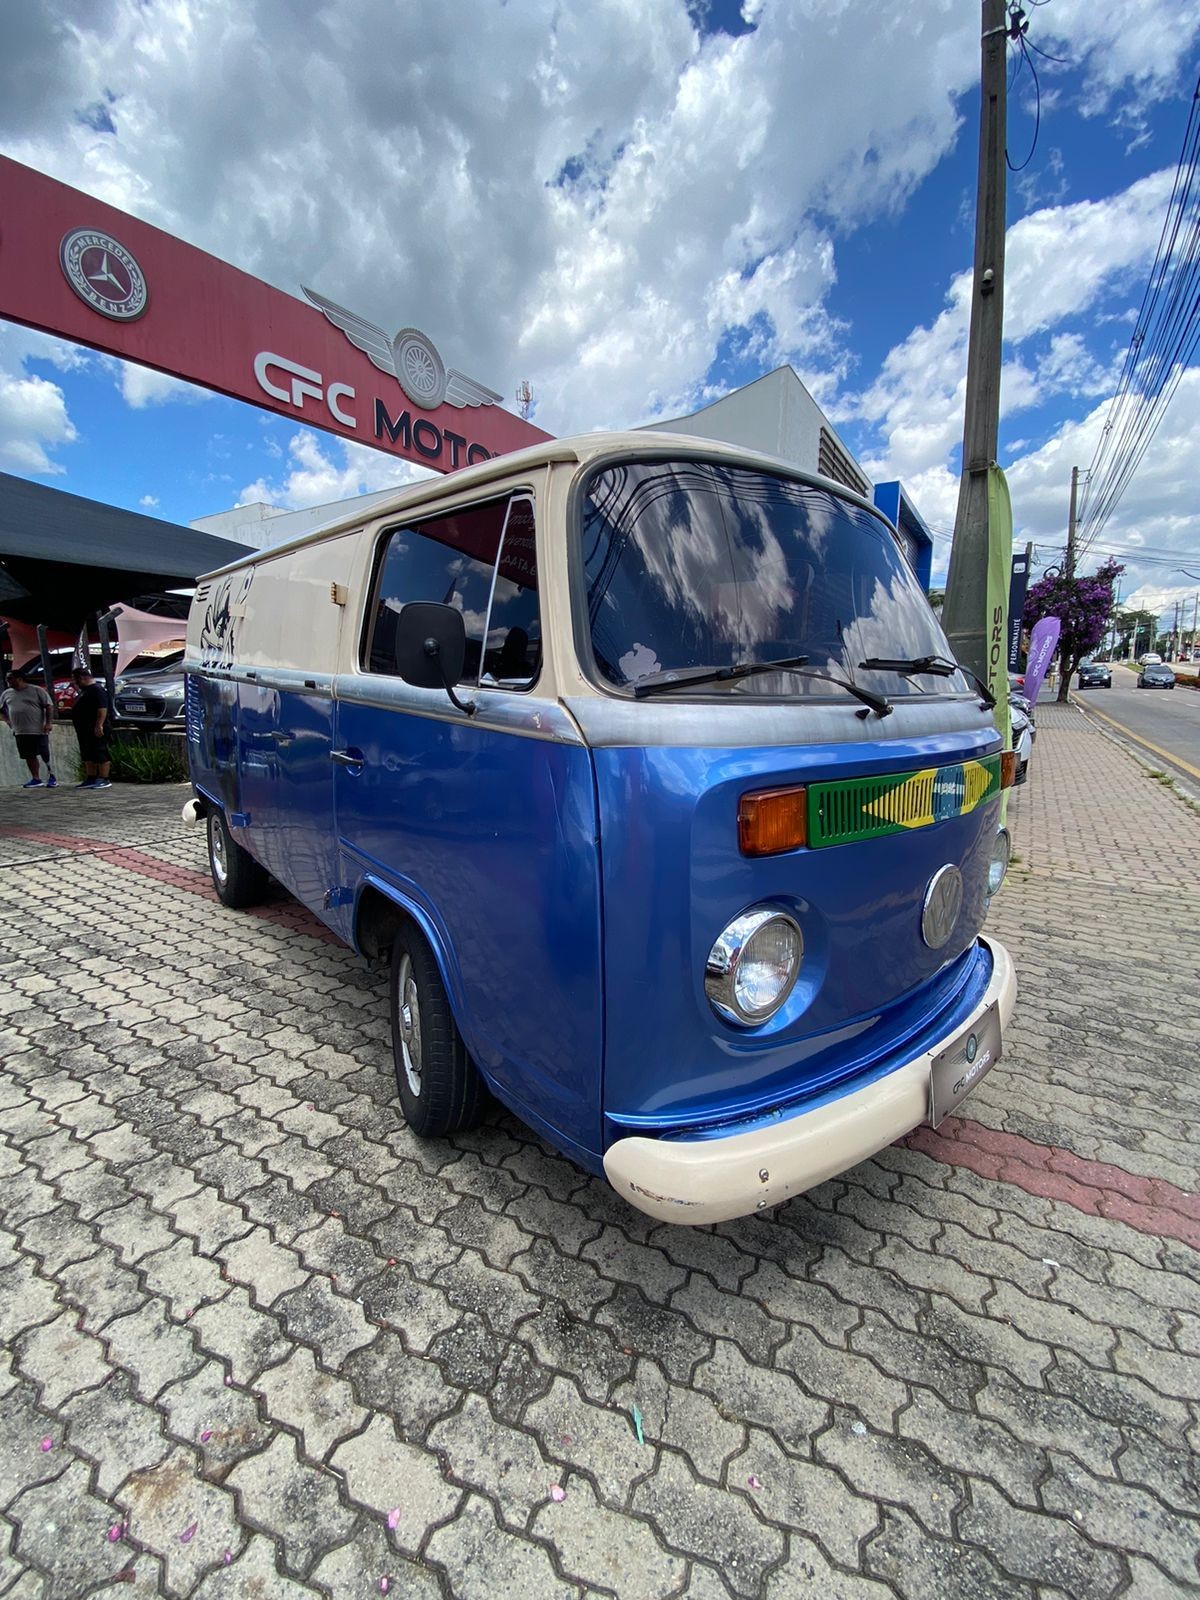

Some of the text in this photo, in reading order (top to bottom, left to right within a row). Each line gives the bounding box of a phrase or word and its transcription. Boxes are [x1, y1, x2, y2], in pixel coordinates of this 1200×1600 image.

[77, 236, 135, 272] MERCEDES
[89, 292, 128, 313] BENZ
[253, 351, 500, 468] CFC MOTO
[1037, 635, 1053, 663] MOTORS
[965, 1050, 991, 1083] MOTORS
